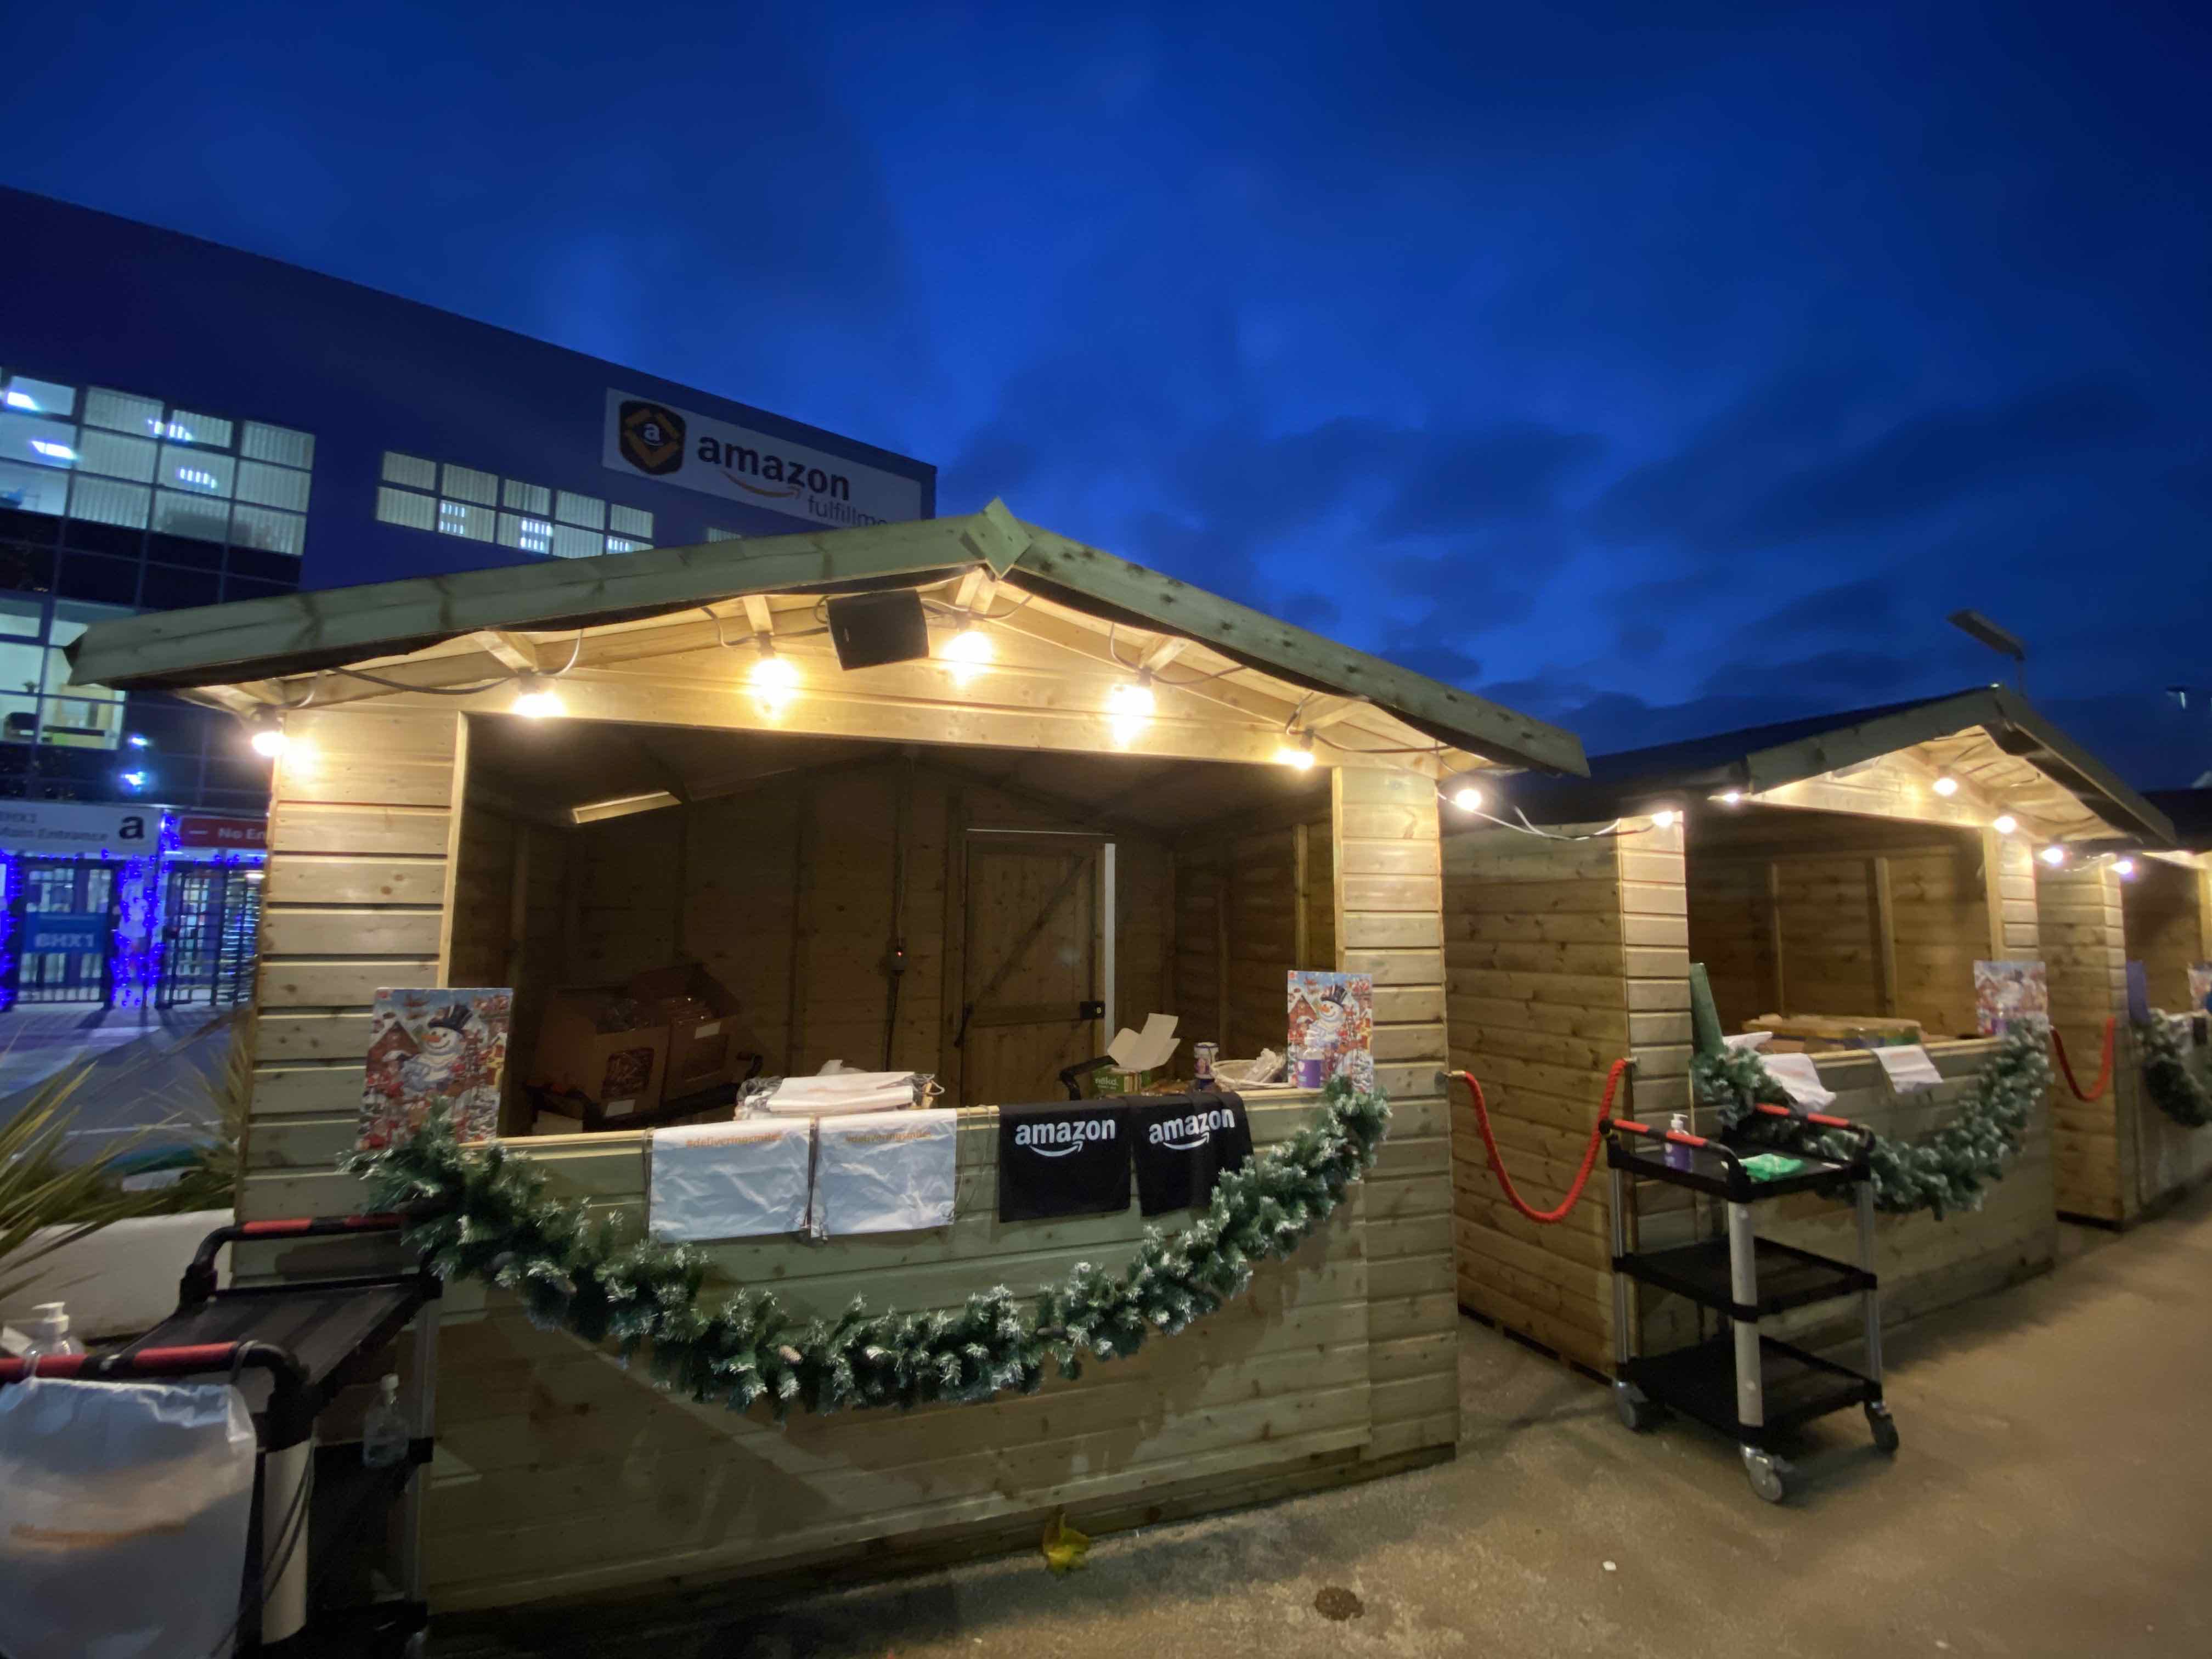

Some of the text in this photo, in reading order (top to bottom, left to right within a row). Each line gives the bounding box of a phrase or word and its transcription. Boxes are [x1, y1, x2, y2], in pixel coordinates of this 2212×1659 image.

[698, 437, 849, 500] amazon
[119, 815, 145, 839] a
[218, 827, 242, 839] No
[35, 933, 94, 947] BHX1
[1014, 1119, 1115, 1146] amazon
[1149, 1108, 1235, 1144] amazon
